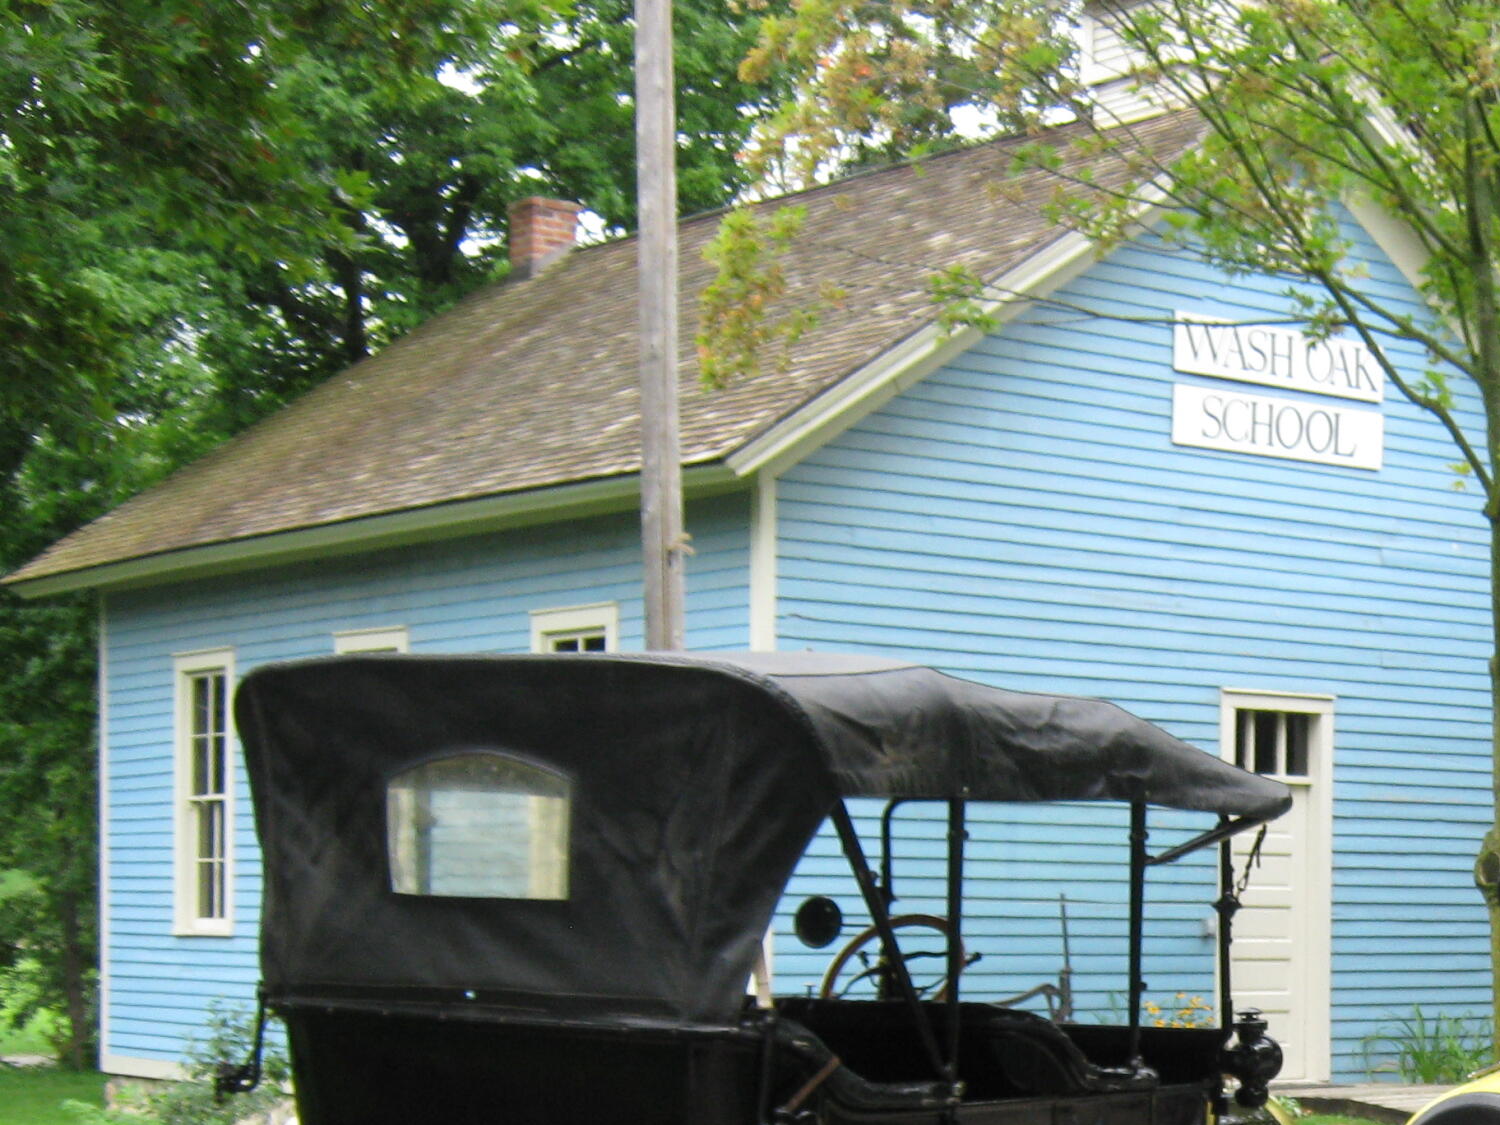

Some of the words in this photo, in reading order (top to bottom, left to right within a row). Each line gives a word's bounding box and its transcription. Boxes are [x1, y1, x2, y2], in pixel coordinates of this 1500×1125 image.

[1181, 322, 1294, 379] WASH
[1305, 338, 1378, 393] OAK
[1201, 394, 1358, 458] SCHOOL
